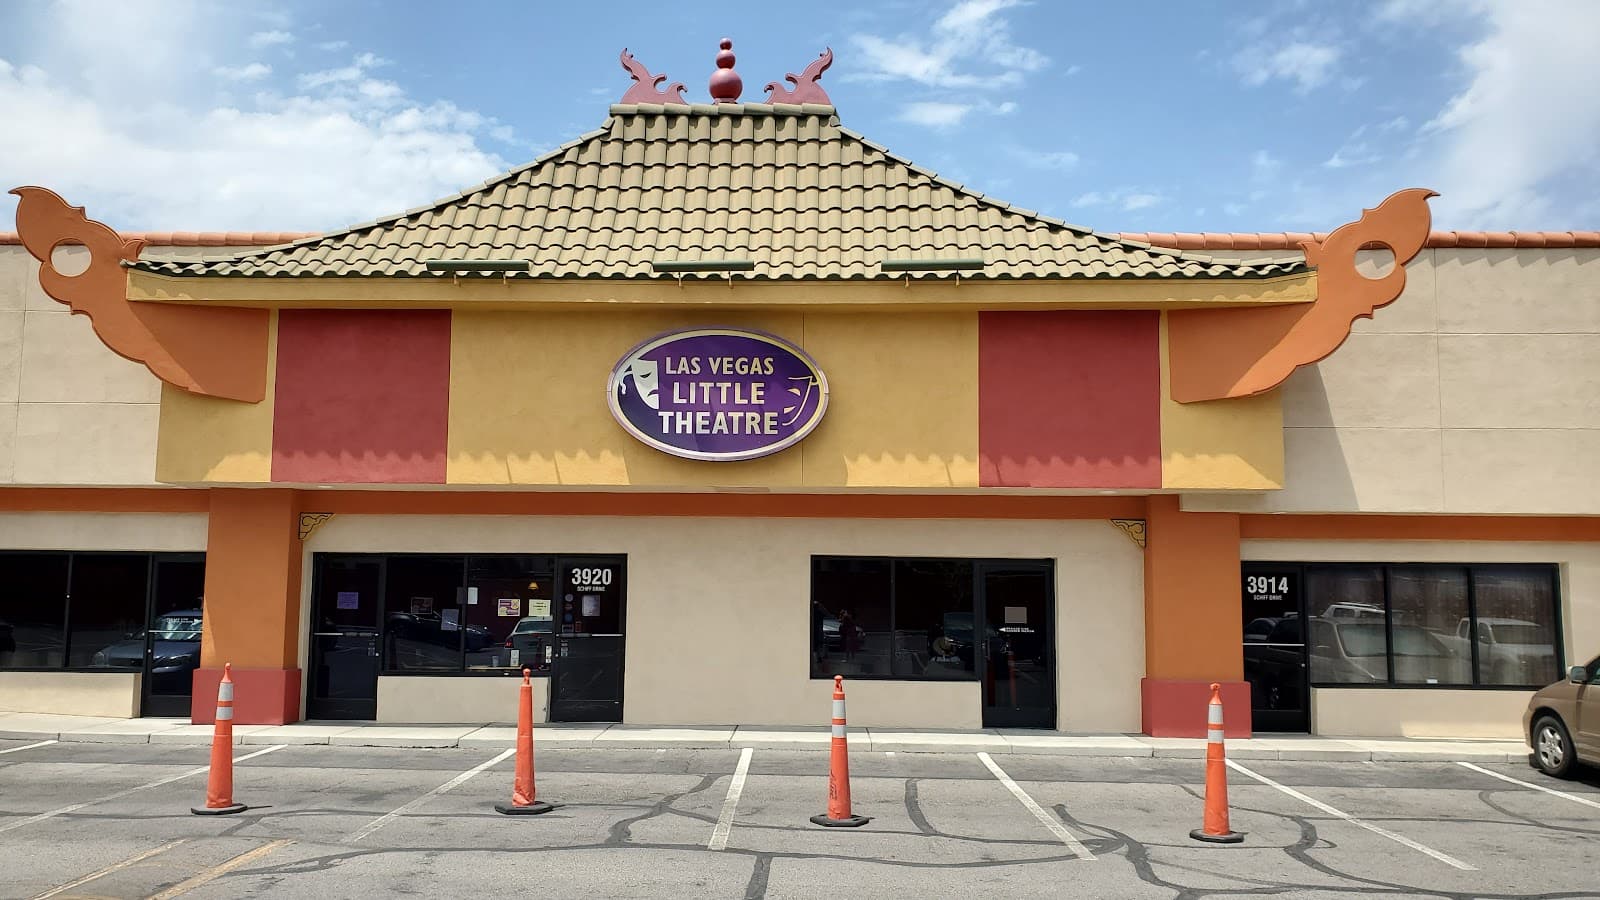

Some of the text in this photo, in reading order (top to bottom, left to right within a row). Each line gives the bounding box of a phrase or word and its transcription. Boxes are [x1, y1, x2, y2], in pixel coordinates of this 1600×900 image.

[665, 356, 775, 375] LAS VEGAS
[672, 381, 766, 405] LITTLE
[657, 411, 779, 435] THEATRE
[571, 568, 612, 585] 3920
[1247, 576, 1289, 594] 3914
